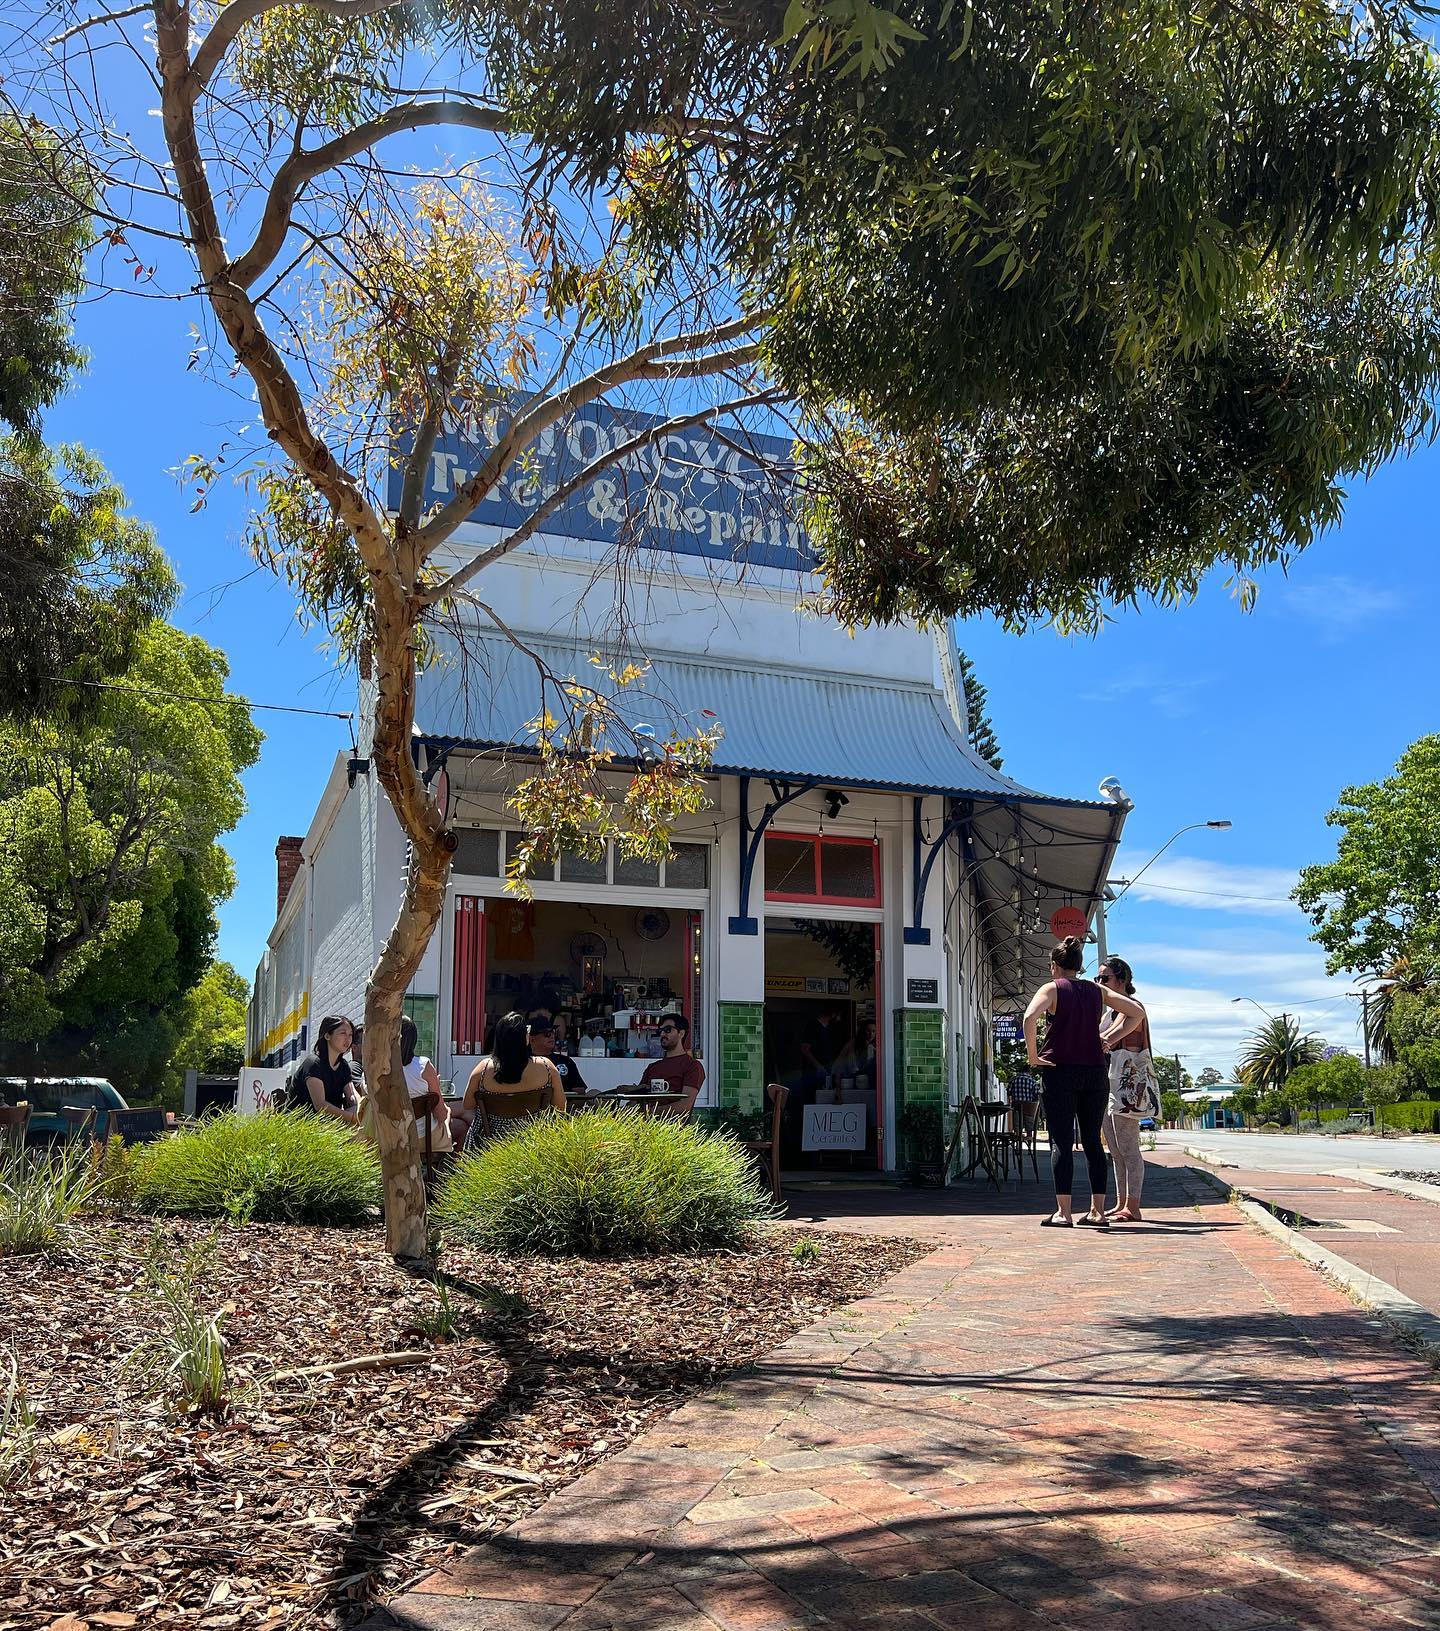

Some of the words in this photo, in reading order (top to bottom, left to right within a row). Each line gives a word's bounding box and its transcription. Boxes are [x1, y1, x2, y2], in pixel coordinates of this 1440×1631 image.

[436, 398, 806, 498] MOTORCYCL
[587, 479, 627, 523] &
[812, 1111, 858, 1132] MEG
[811, 1134, 857, 1144] Ceramics
